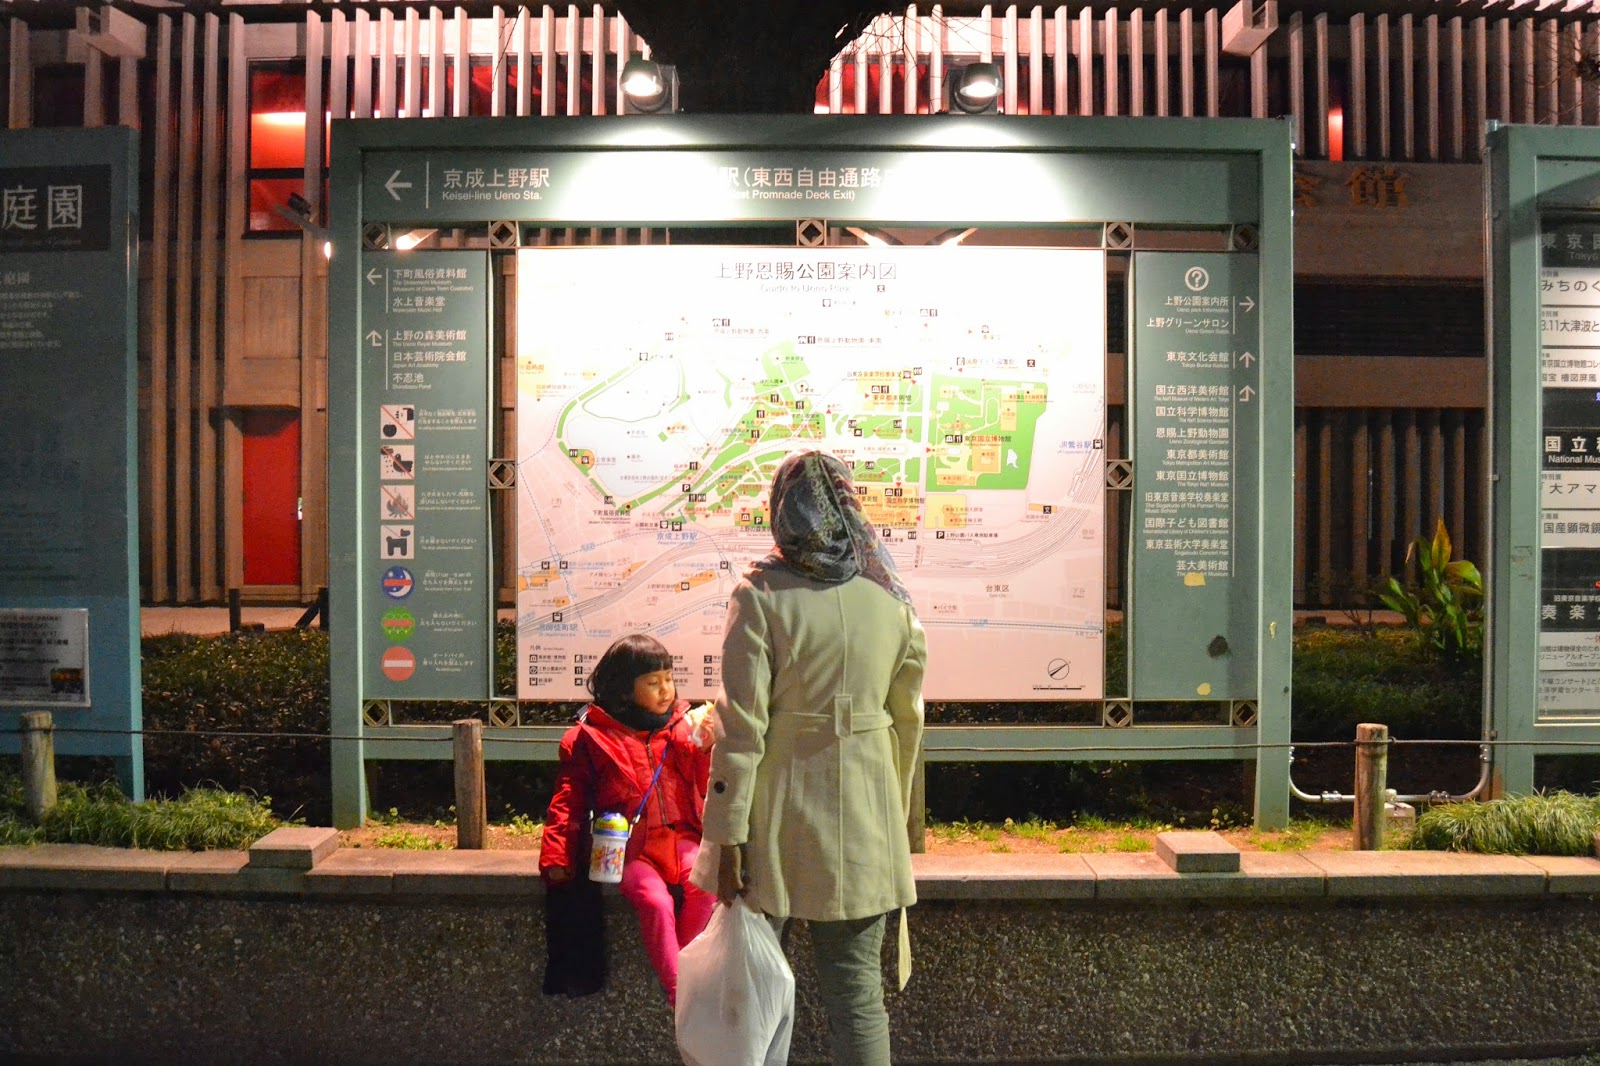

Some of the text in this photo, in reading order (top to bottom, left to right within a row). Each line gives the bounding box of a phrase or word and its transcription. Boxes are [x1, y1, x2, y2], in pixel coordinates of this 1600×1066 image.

[443, 168, 550, 188] 京成上野駅
[442, 191, 542, 200] Keisei-line Ueno Sta.
[752, 190, 855, 201] Promnade Deck Exit)
[2, 185, 83, 230] 庭園
[393, 268, 467, 279] 下町風俗資料館
[715, 262, 897, 280] 上野恩賜公園案内図
[1542, 280, 1600, 292] みちのく
[393, 296, 446, 307] 水上音楽堂
[1164, 296, 1229, 307] 上野公園案内所
[1146, 318, 1229, 328] 上野グリーンサロン
[1541, 320, 1600, 332] 3.11大津波と
[393, 330, 466, 341] 上野の森美術館
[393, 351, 467, 362] 日本芸術院会館
[1166, 351, 1229, 362] 東京文化会館
[393, 372, 424, 383] 不忍池
[1155, 385, 1229, 396] 国立西洋美術館
[1155, 407, 1229, 417] 国立科学博物館
[1156, 428, 1229, 439] 恩賜上野動物園
[1166, 449, 1229, 460] 東京都美術館
[1548, 455, 1582, 463] National
[1156, 471, 1229, 481] 東京国立博物館
[1145, 492, 1229, 503] 旧東京音楽学校奏楽堂
[1144, 518, 1229, 529] 国際子ども図書館
[656, 532, 698, 541] 京成上野駅
[1146, 539, 1228, 550] 東京芸術大学奏楽堂
[1176, 560, 1229, 571] 芸大美術館
[985, 585, 1010, 593] 台東区
